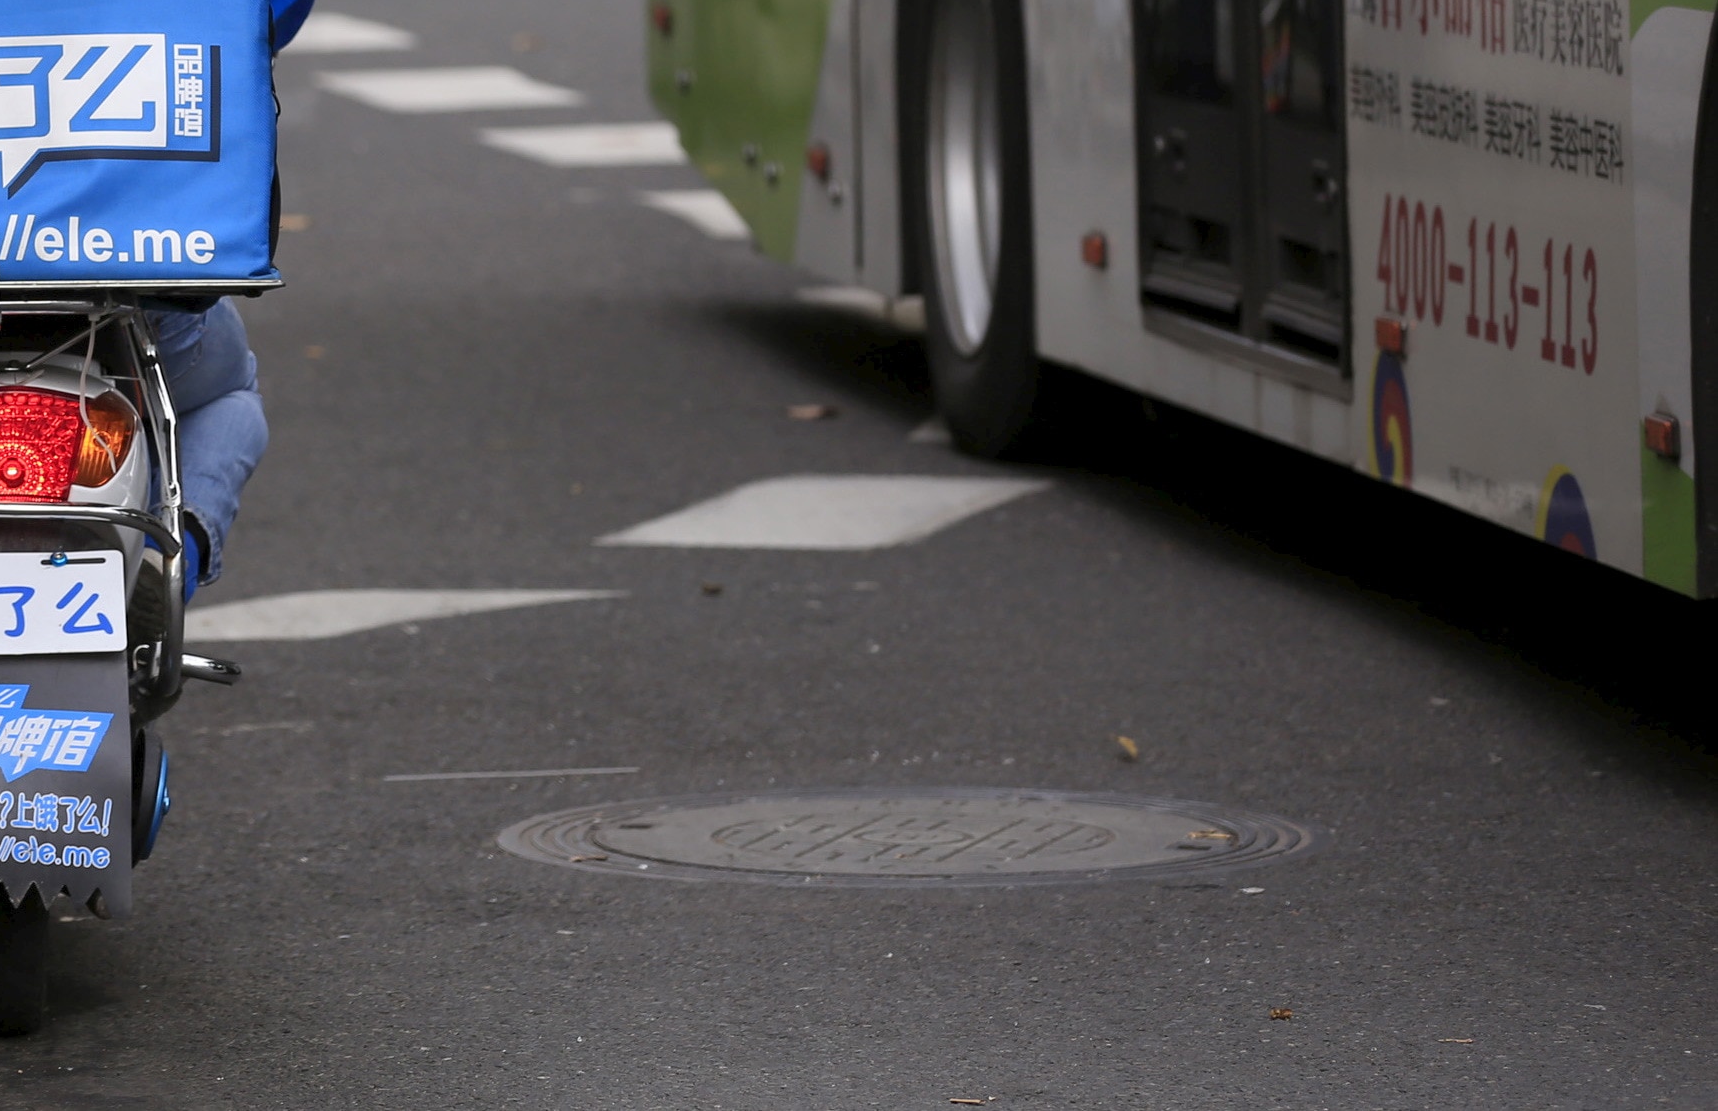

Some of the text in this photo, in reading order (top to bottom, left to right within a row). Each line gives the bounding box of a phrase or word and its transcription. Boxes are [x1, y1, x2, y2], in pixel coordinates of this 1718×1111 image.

[173, 43, 204, 137] 品牌馆
[1377, 192, 1598, 376] 4000-113-113
